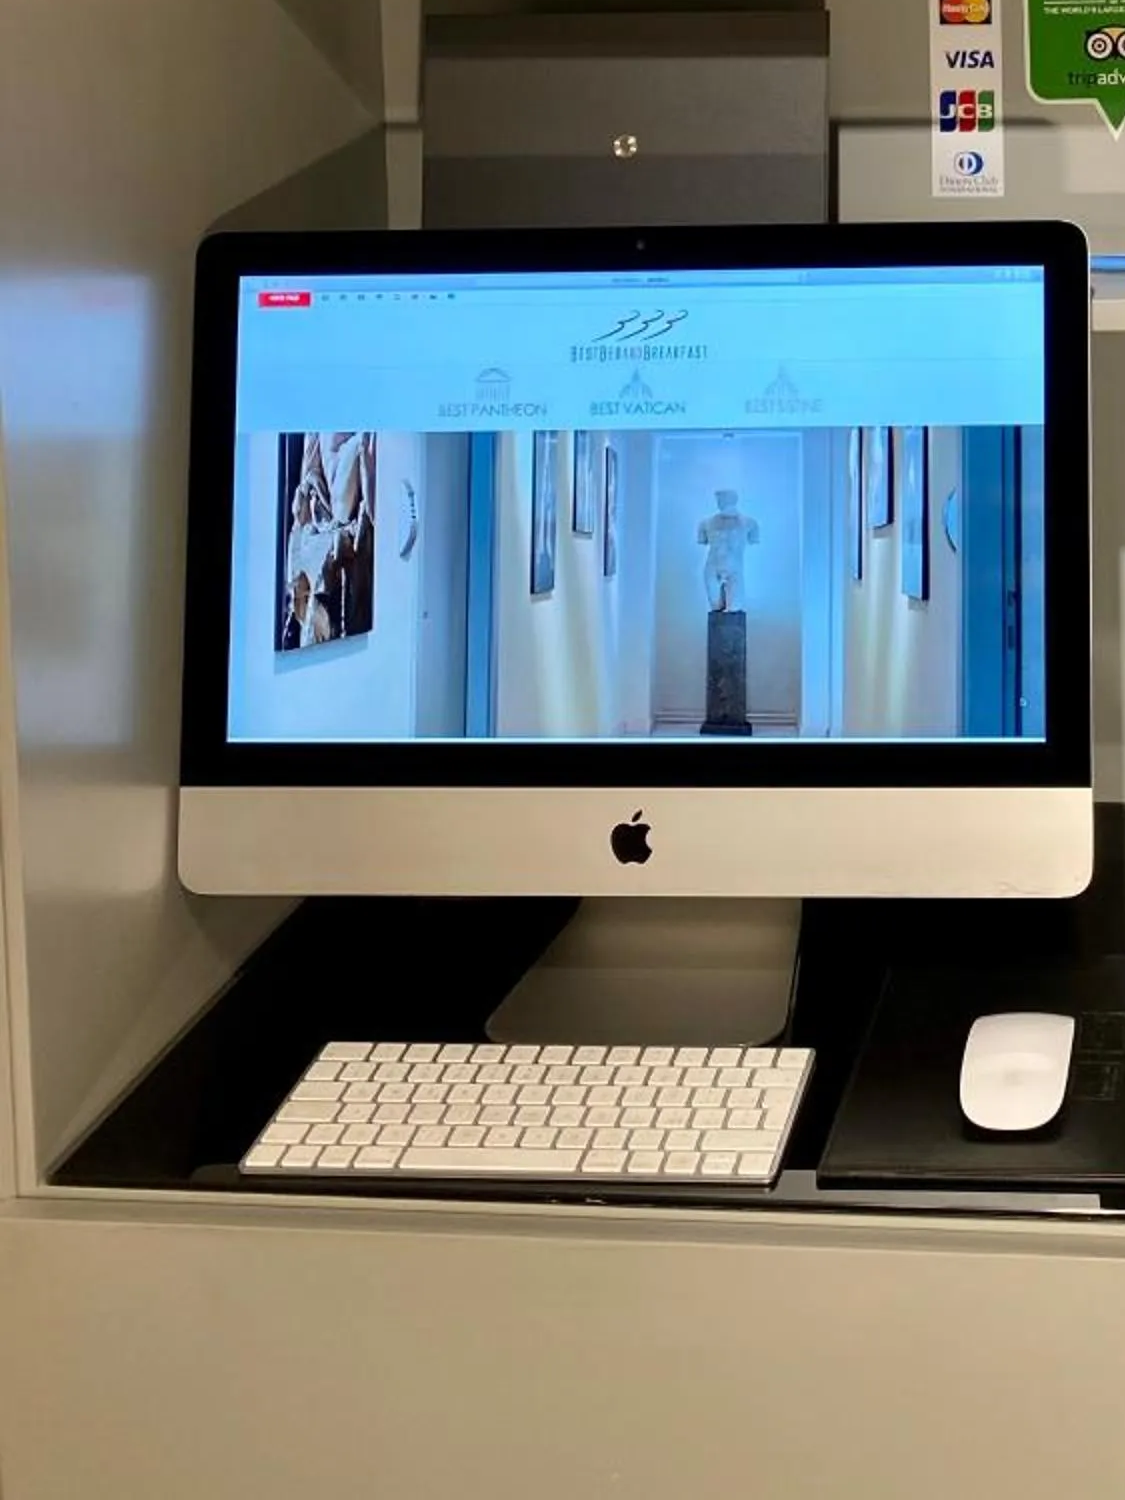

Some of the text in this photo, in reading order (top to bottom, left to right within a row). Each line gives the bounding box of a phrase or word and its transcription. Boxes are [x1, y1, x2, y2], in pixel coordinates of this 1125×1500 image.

[946, 50, 995, 68] VISA
[438, 401, 549, 418] BEST PANTHEON
[590, 400, 686, 416] BEST VATICAN
